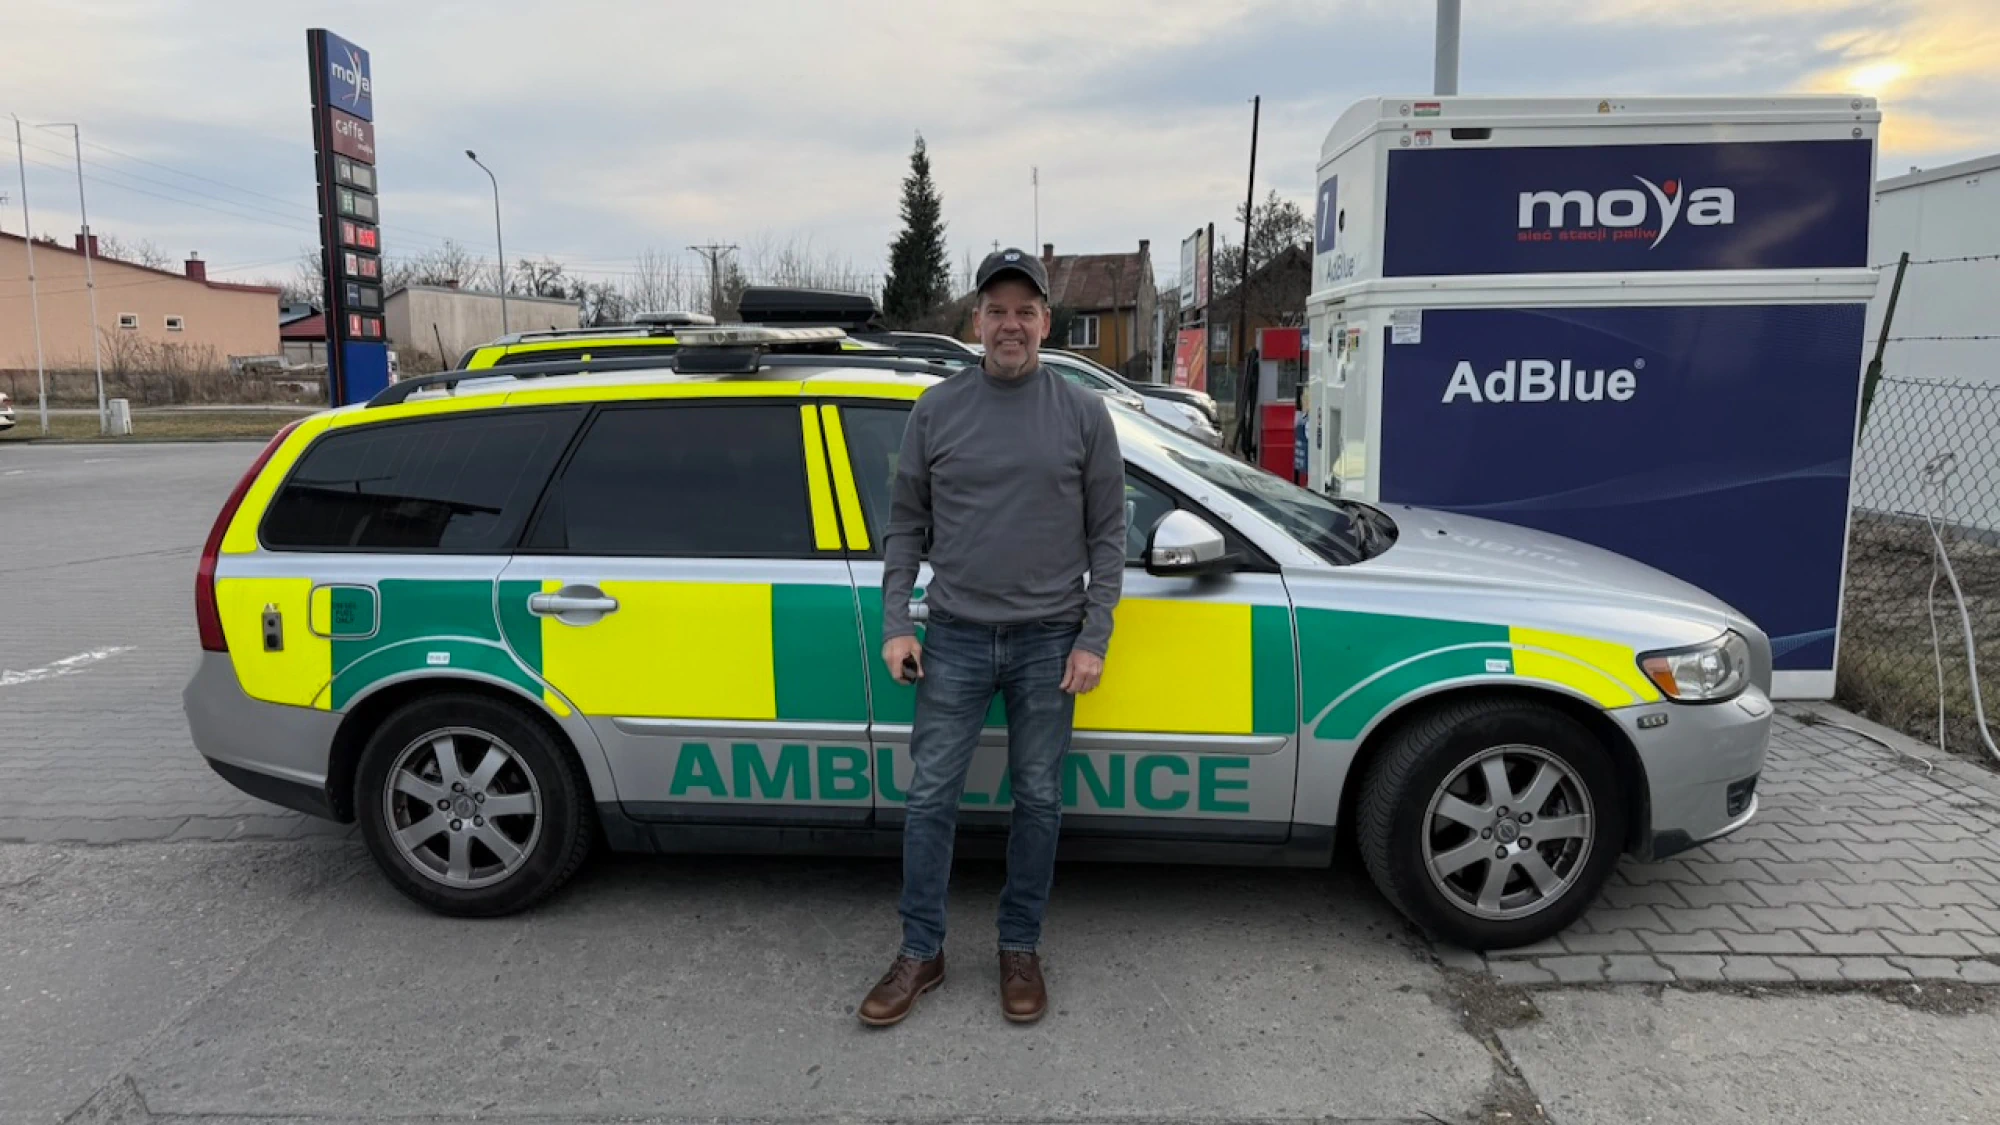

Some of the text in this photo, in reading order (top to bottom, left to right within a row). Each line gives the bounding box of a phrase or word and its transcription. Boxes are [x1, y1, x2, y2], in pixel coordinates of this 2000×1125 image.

[331, 43, 370, 108] moya
[1518, 174, 1735, 250] moya
[1559, 228, 1607, 241] stacji
[1613, 227, 1657, 242] paliw
